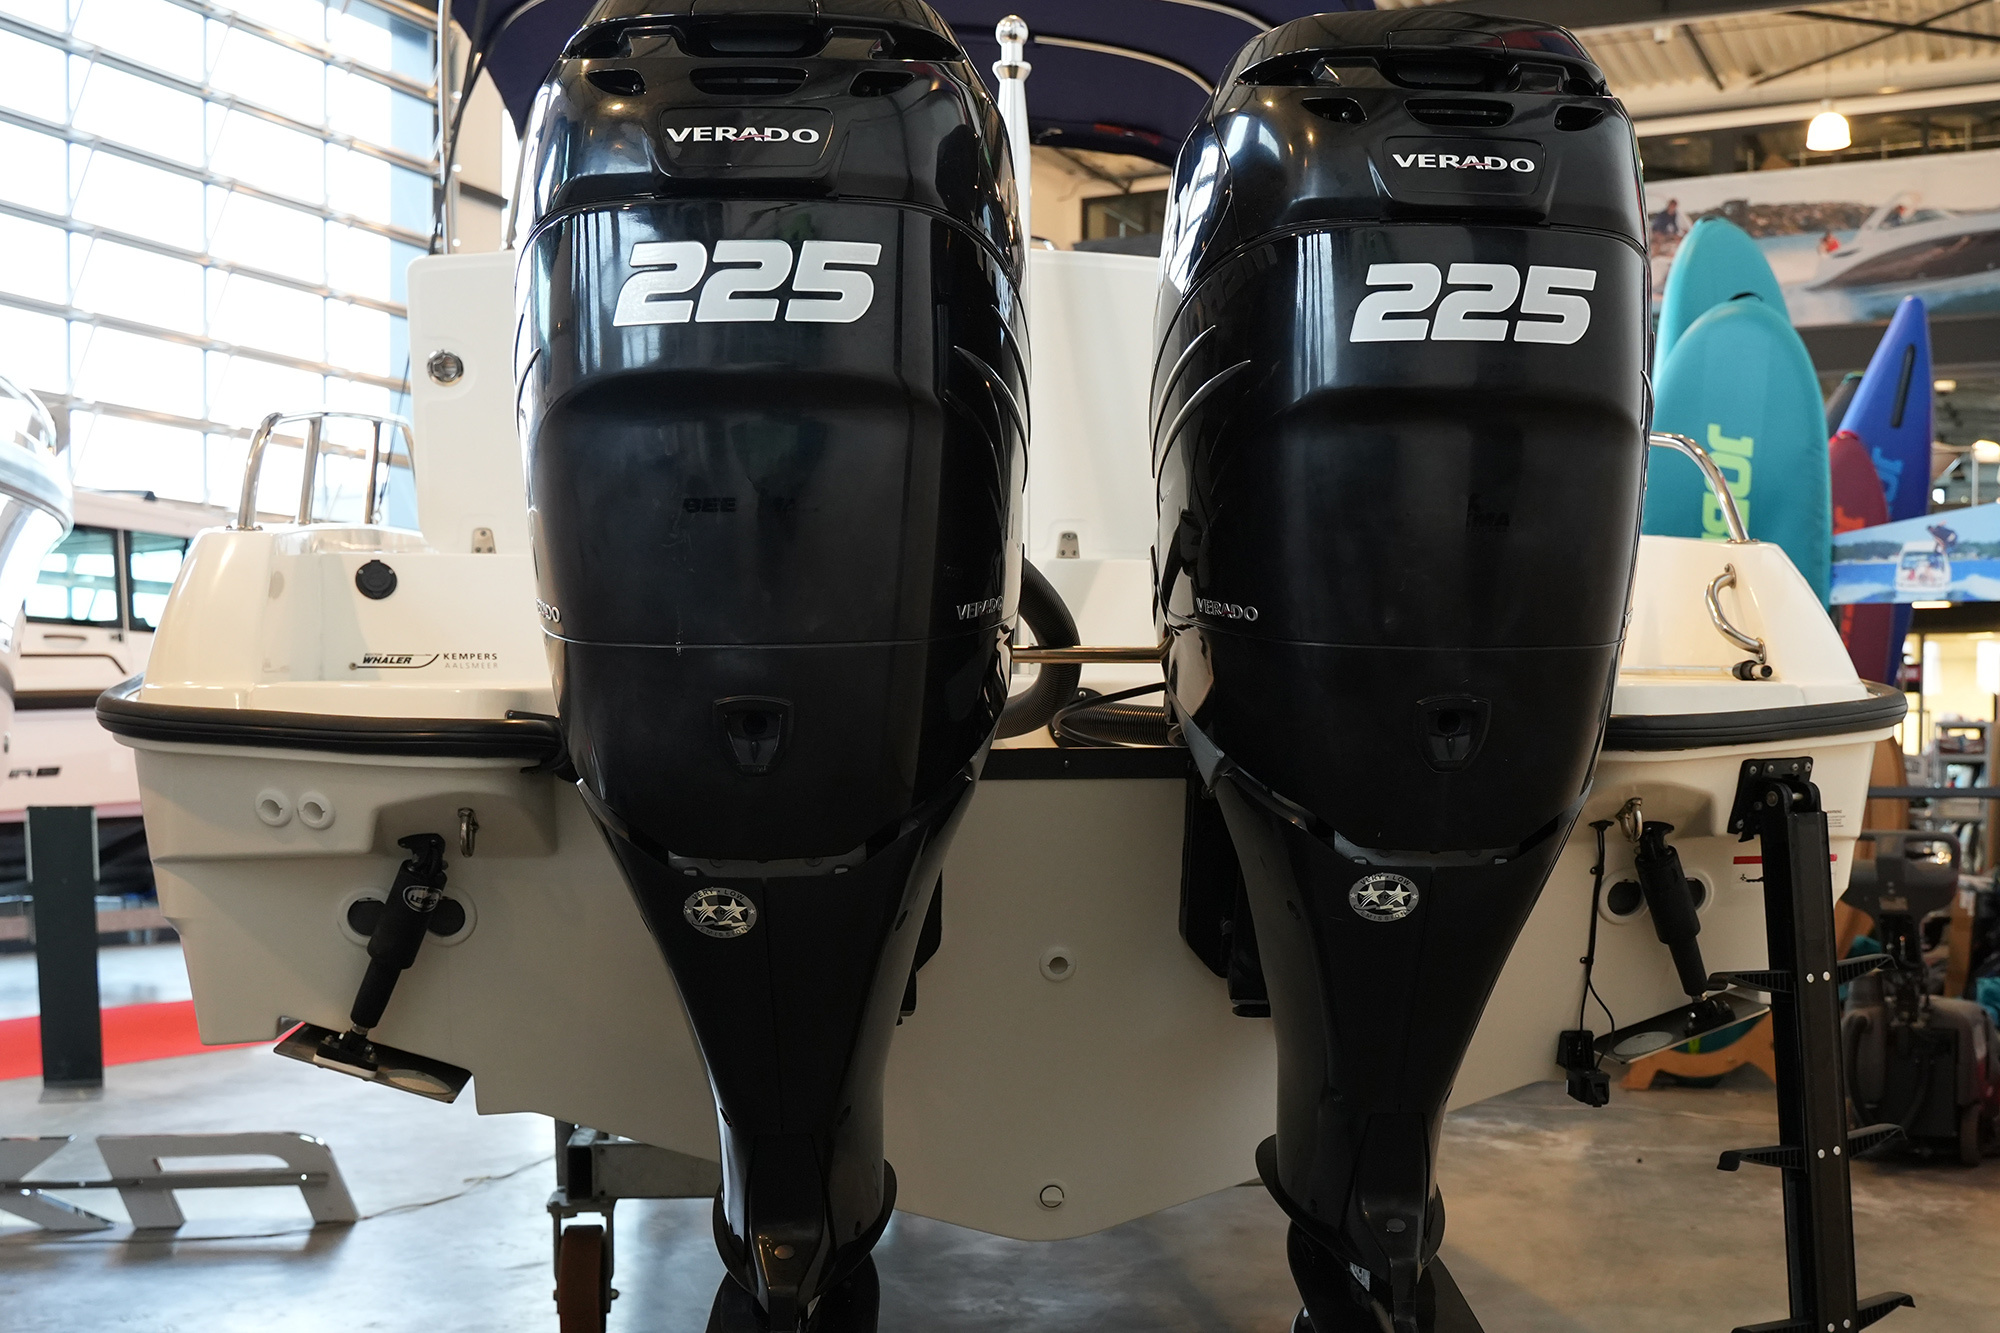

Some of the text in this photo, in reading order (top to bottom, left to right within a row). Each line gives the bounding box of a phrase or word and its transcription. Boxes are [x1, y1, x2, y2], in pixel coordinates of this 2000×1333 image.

[666, 126, 820, 144] VERADO
[1392, 153, 1536, 173] VERADO
[612, 239, 882, 327] 225
[1349, 262, 1597, 345] 225
[1702, 422, 1754, 542] JOB
[956, 595, 1004, 620] VERADO
[1195, 597, 1259, 622] VERADO
[362, 656, 413, 665] WHALER
[443, 653, 498, 661] KEMPERS
[1360, 873, 1411, 886] VERY LOW
[692, 887, 745, 901] VERY LOW
